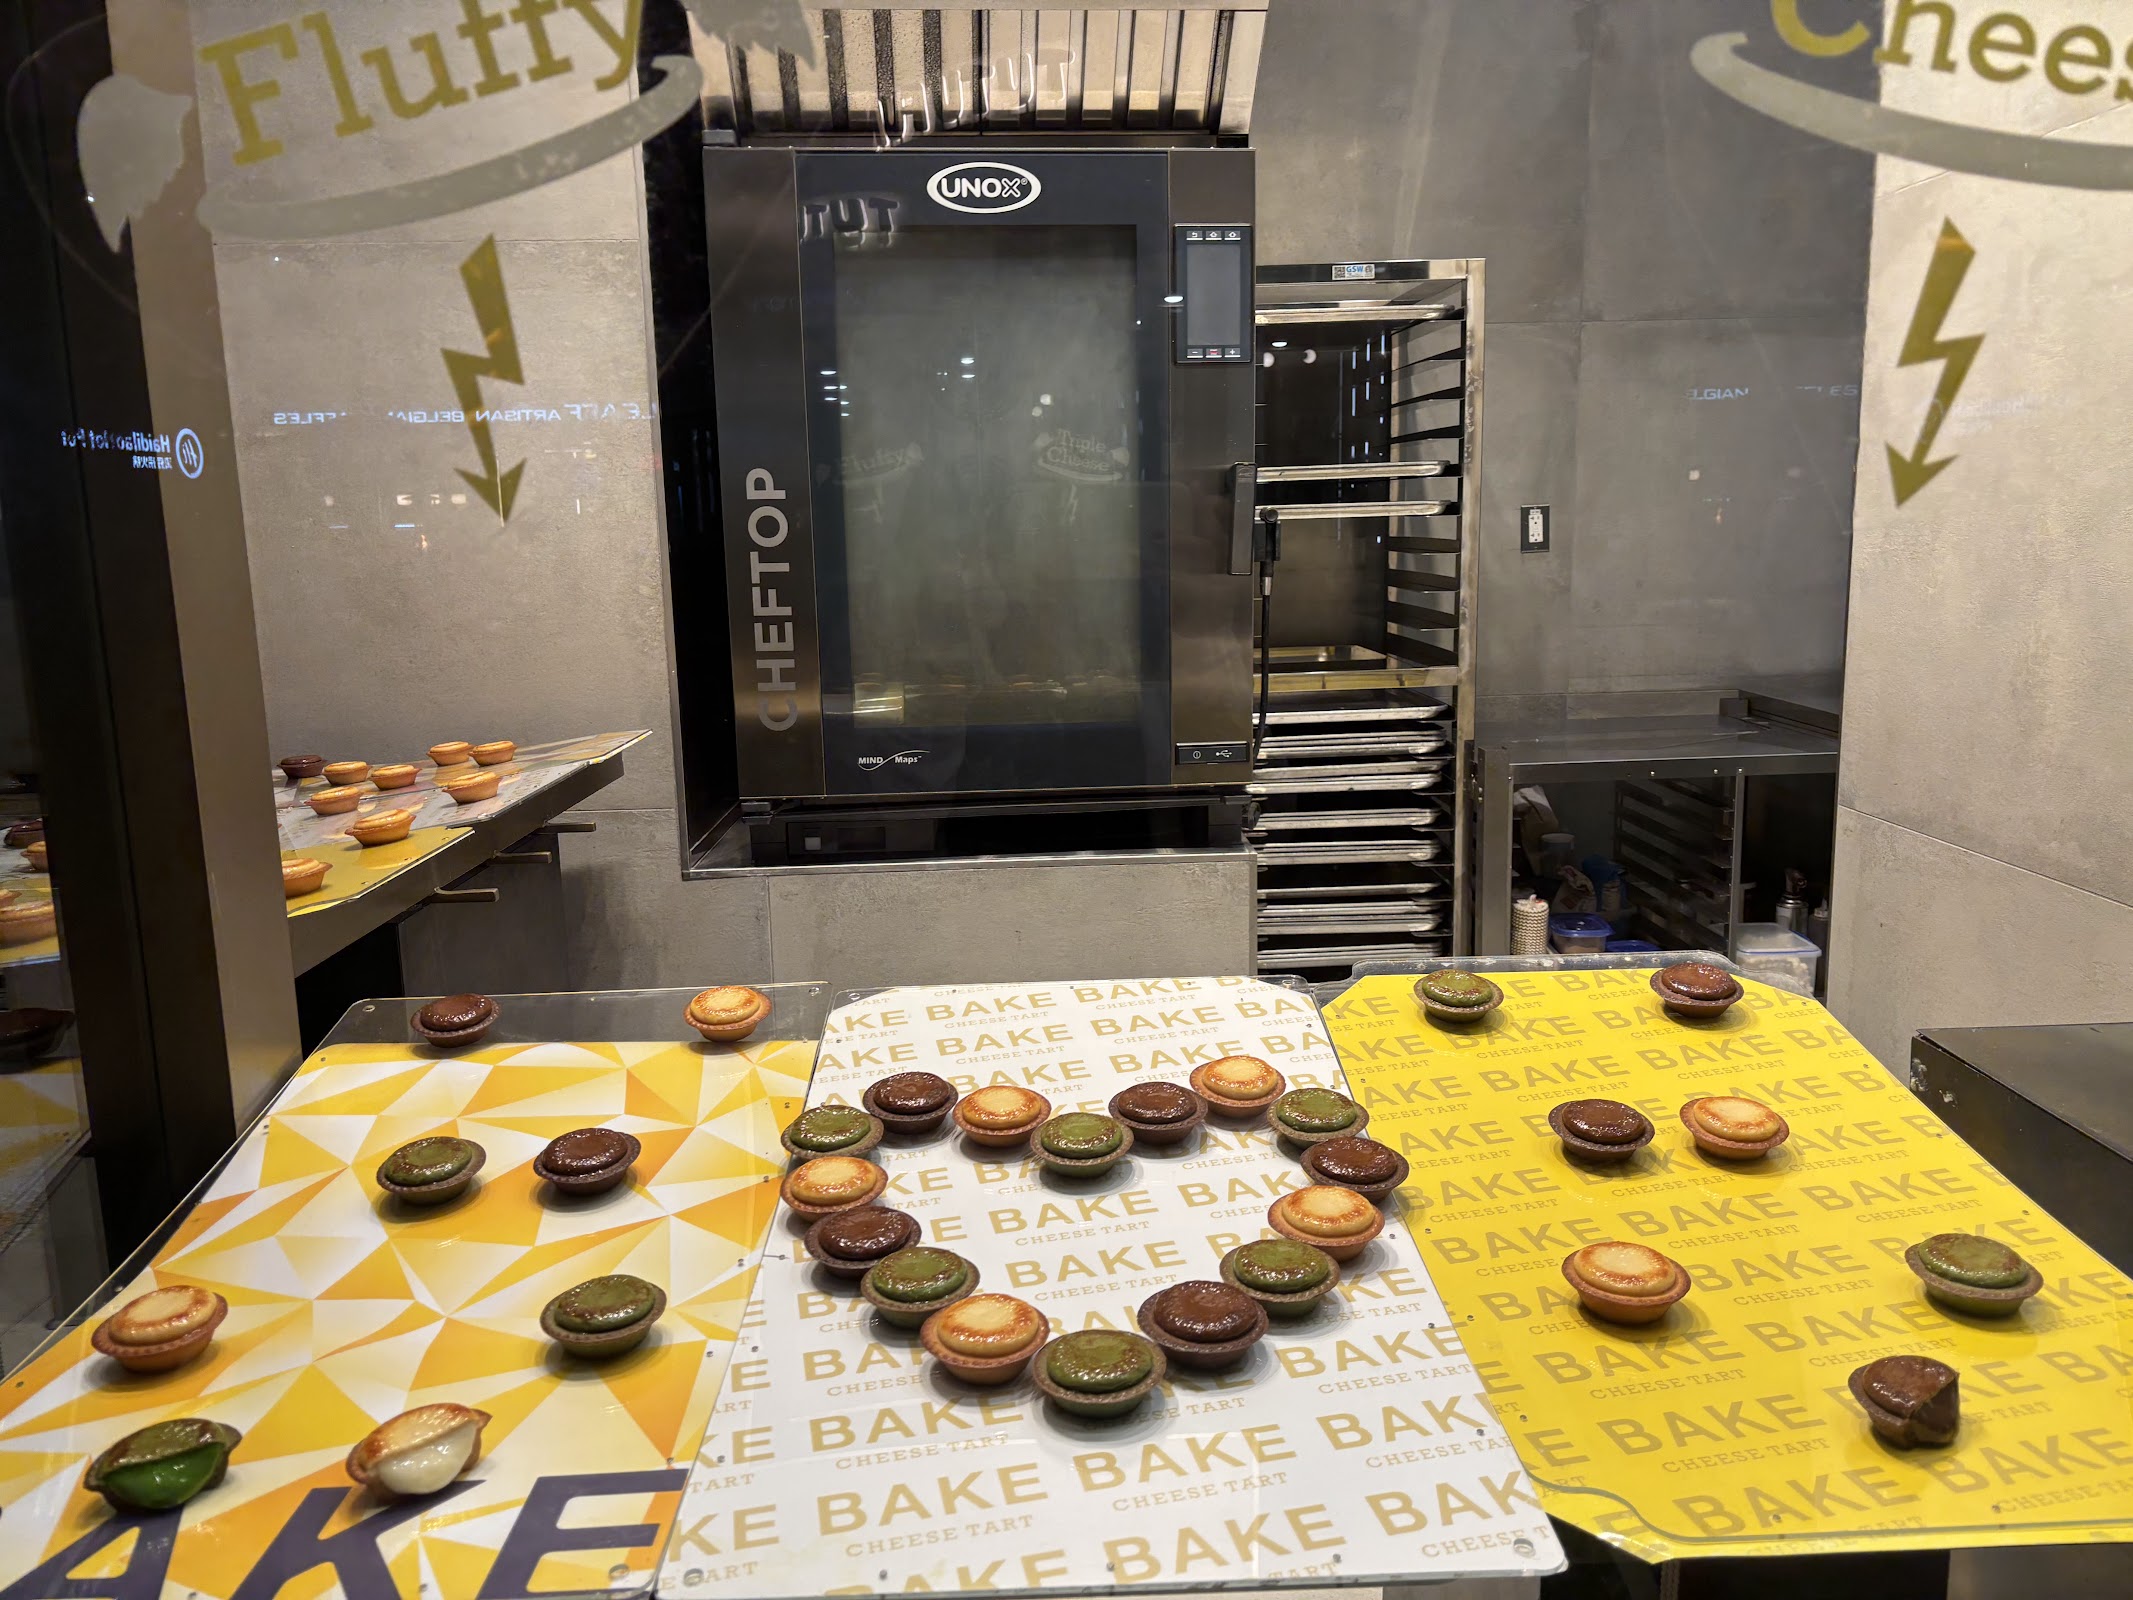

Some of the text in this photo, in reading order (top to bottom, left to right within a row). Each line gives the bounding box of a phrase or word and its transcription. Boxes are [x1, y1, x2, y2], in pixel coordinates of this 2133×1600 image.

[1346, 265, 1364, 273] GSW
[745, 467, 798, 732] CHEFTOP
[858, 756, 918, 765] MIND Maps
[1073, 979, 1202, 1003] BAKE
[1552, 970, 1649, 993] BAK
[925, 991, 1057, 1021] BAKE
[1095, 994, 1196, 1010] CHEESE TART
[944, 1011, 1048, 1029] CHEESE TART
[1090, 1005, 1226, 1036] BAKE
[1360, 1019, 1395, 1029] TART
[860, 1030, 899, 1040] TART
[936, 1023, 1074, 1057] BAKE
[1114, 1026, 1220, 1045] CHEESE TART
[956, 1045, 1065, 1065] CHEESE TART
[1108, 1040, 1250, 1073] BAKE
[1476, 1040, 1584, 1059] CHEESE TART
[1636, 1034, 1784, 1071] BAKE
[866, 1066, 907, 1077] TART
[1134, 1071, 1190, 1083] CHEES
[1388, 1059, 1430, 1070] TART
[1479, 1055, 1630, 1092] BAKE
[1677, 1059, 1785, 1080] CHEESE TART
[1041, 1084, 1084, 1095] TART
[1363, 1075, 1473, 1108] AKE
[1517, 1081, 1628, 1102] CHEESE TART
[1420, 1103, 1469, 1116] TART
[1398, 1120, 1514, 1156] AKE
[884, 1150, 929, 1162] TART
[1182, 1155, 1255, 1170] CHEESE
[1466, 1149, 1511, 1163] TART
[1857, 1150, 1910, 1164] TART
[1177, 1170, 1300, 1208] BAK
[1402, 1168, 1560, 1212] BAKE
[1611, 1173, 1736, 1197] CHEESE TART
[1800, 1168, 1979, 1212] BAKE
[988, 1189, 1159, 1234] BAKE
[1430, 1199, 1559, 1224] CHEESE TART
[1617, 1192, 1799, 1237] BAKE
[1856, 1199, 1983, 1223] CHEESE TART
[1015, 1220, 1150, 1246] CHEESE TART
[1430, 1218, 1607, 1265] BAKE
[1668, 1224, 1800, 1250] CHEESE TART
[1004, 1240, 1187, 1289] BAKE
[1476, 1256, 1562, 1278] CHEESE
[1684, 1244, 1870, 1293] BAKE
[2028, 1250, 2064, 1263] ART
[1033, 1274, 1178, 1302] CHEESE TART
[1733, 1279, 1874, 1305] CHEESE TART
[1367, 1302, 1422, 1317] TART
[1744, 1300, 1952, 1353] BAKE
[1274, 1322, 1470, 1379] BAKE
[1534, 1330, 1745, 1385] BAKE
[1809, 1337, 1957, 1367] CHEESE TART
[827, 1374, 922, 1397] CHEESE
[1318, 1372, 1411, 1394] CHEESE
[1415, 1363, 1474, 1380] TART
[1590, 1369, 1746, 1400] CHEESE TART
[1186, 1397, 1246, 1415] TART
[809, 1391, 1024, 1452] BAKE
[1597, 1394, 1826, 1456] BAKE
[835, 1445, 939, 1470] CHEESE
[1073, 1424, 1297, 1493] BAKE
[1365, 1443, 1463, 1468] CHEESE
[1662, 1437, 1830, 1473] CHEESE TART
[1920, 1427, 2133, 1493] BAKE
[817, 1463, 1048, 1537] BAKE
[1112, 1472, 1287, 1511] CHEESE TART
[1672, 1465, 1921, 1537] BAKE
[846, 1515, 1033, 1557] CHEESE TART
[1103, 1504, 1346, 1584] BAKE
